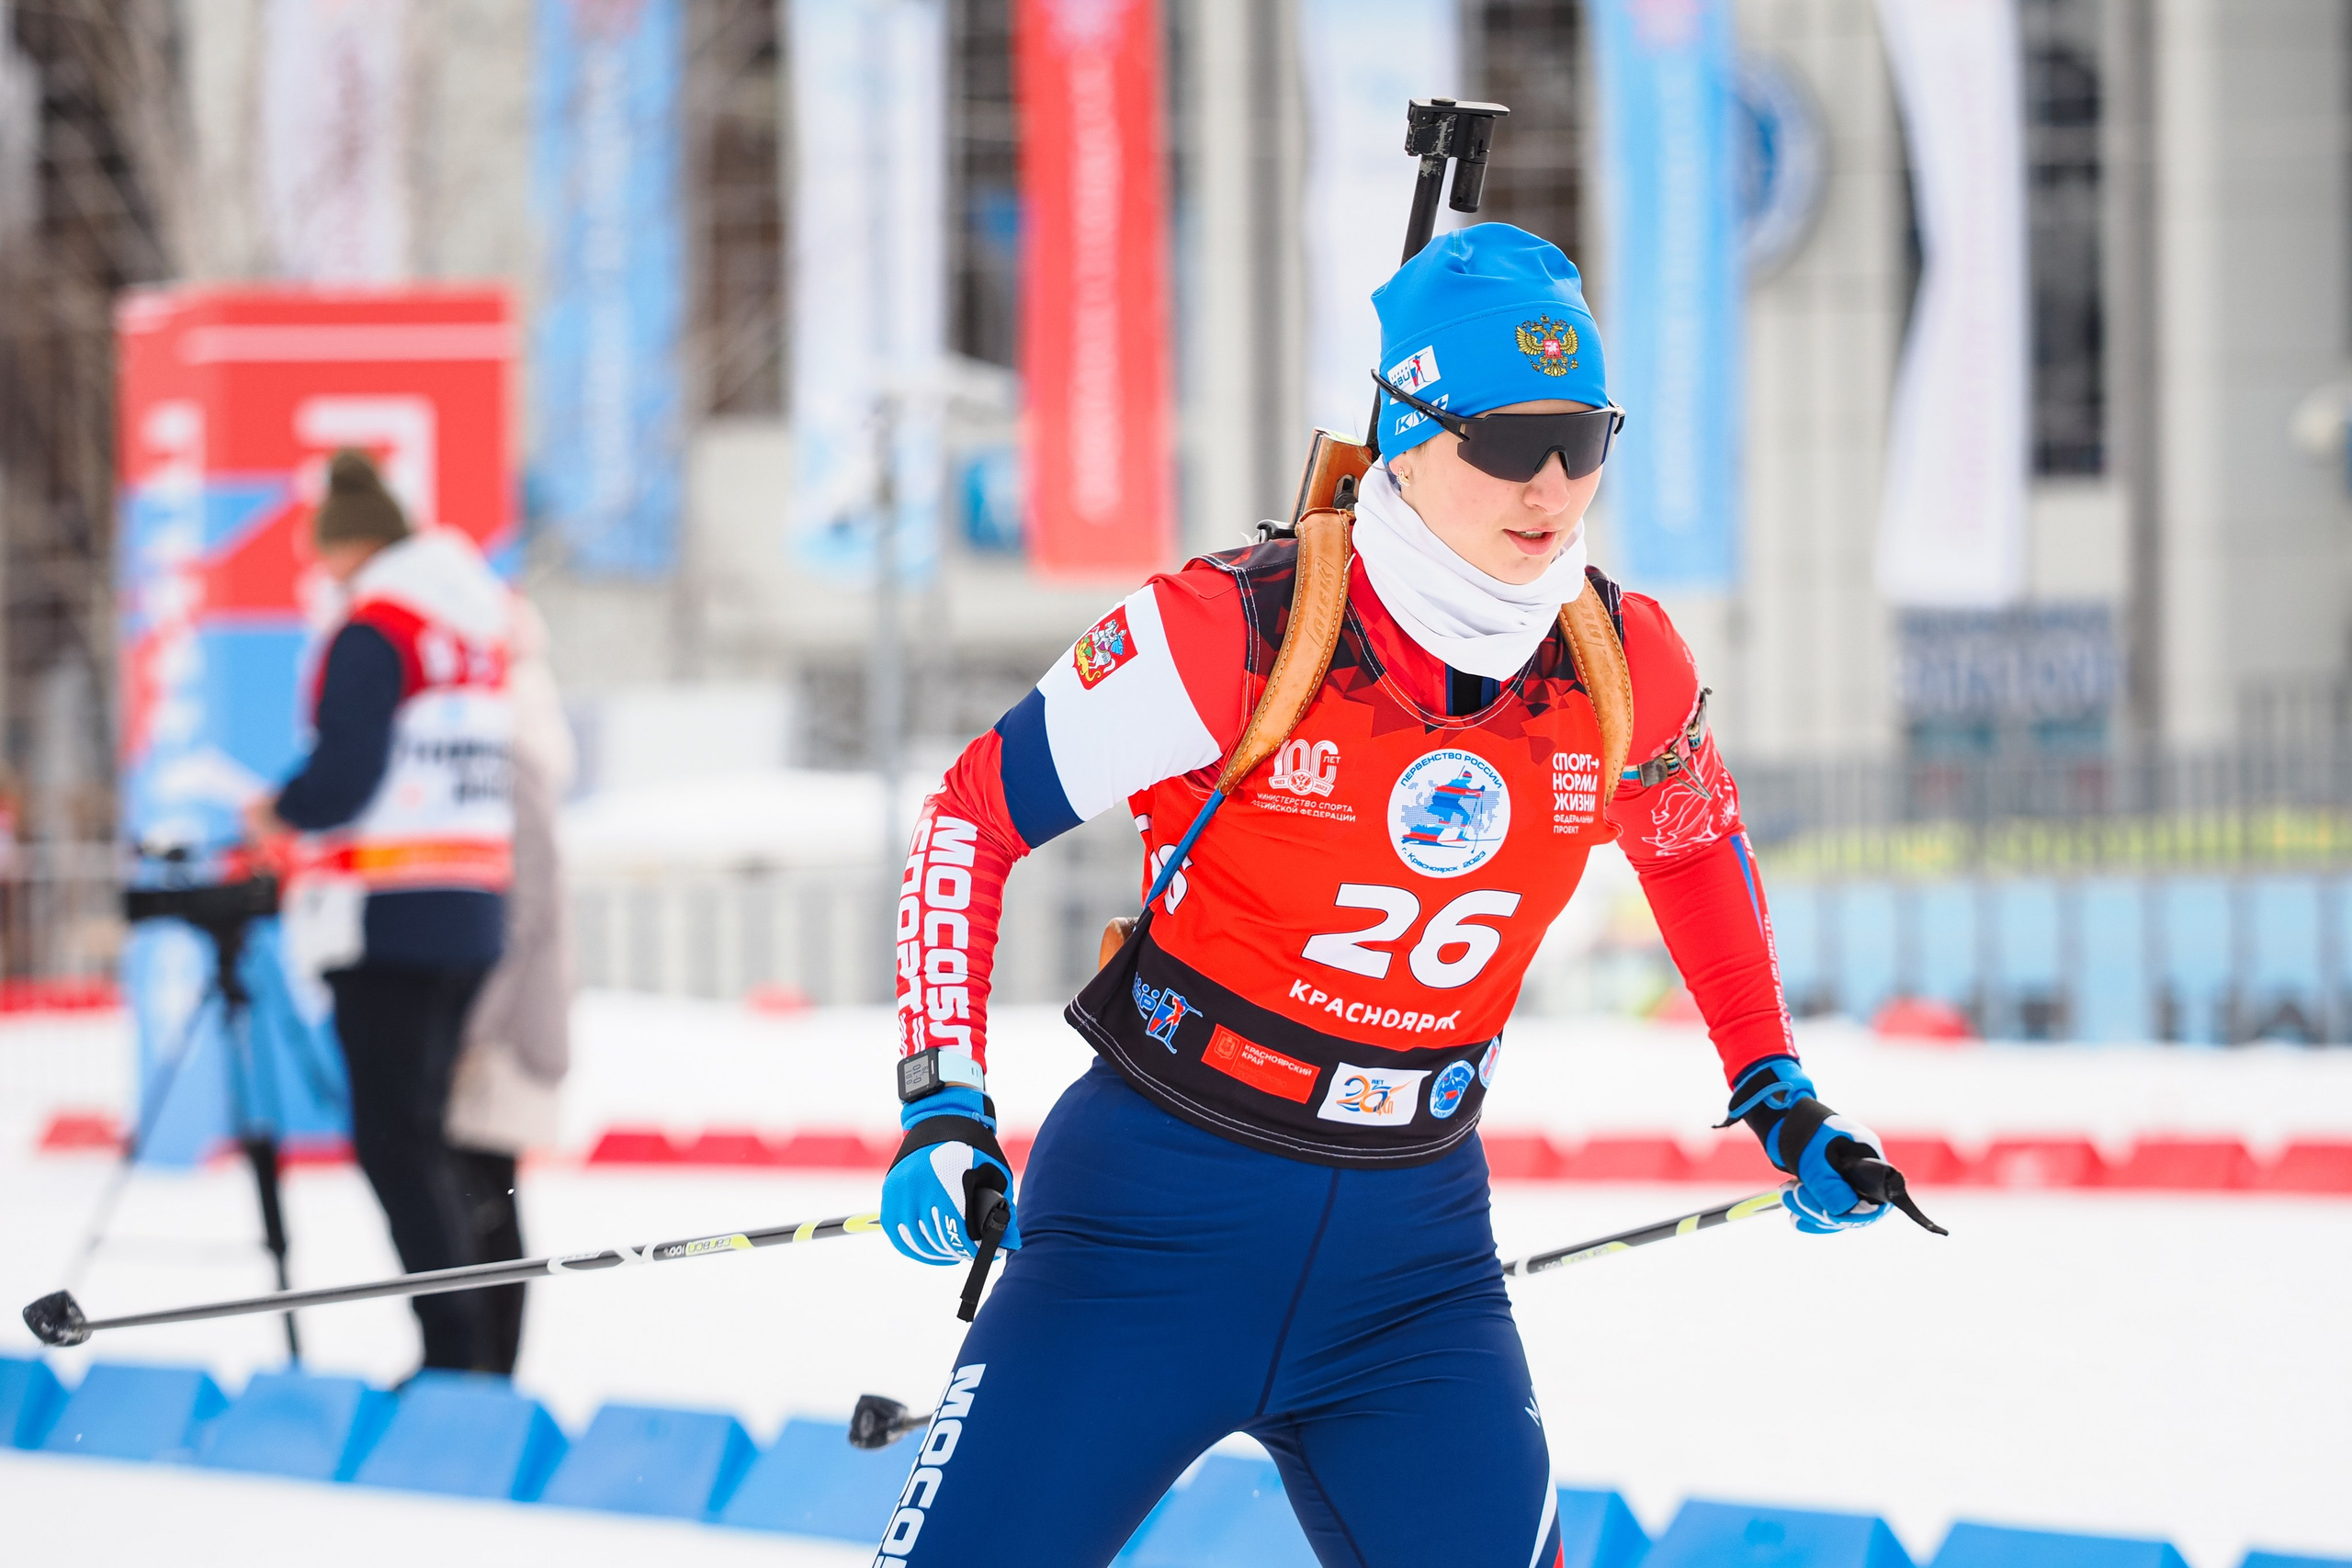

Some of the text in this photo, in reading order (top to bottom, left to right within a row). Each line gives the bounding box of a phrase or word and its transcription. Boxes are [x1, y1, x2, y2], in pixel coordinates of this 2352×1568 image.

[1323, 756, 1341, 764] ЛЕТ
[1400, 752, 1503, 789] ПЕРВЕНСТВО РОССИИ
[1553, 773, 1598, 793] НОРМА
[1257, 793, 1353, 813] МИНИСТЕРСТВО СПОРТА
[1554, 793, 1596, 812] ЖИЗНИ
[1299, 808, 1356, 822] ФЕДЕРАЦИИ
[1553, 826, 1579, 834] ПРОЕКТ
[1408, 853, 1458, 874] Красноярск
[1463, 851, 1487, 868] 2023
[1301, 883, 1523, 989] 26
[1241, 1051, 1264, 1066] КРАЙ
[1244, 1044, 1312, 1077] КРАСНОЯРСКИЙ
[944, 1214, 964, 1247] SKI
[880, 1363, 987, 1568] МОСО
